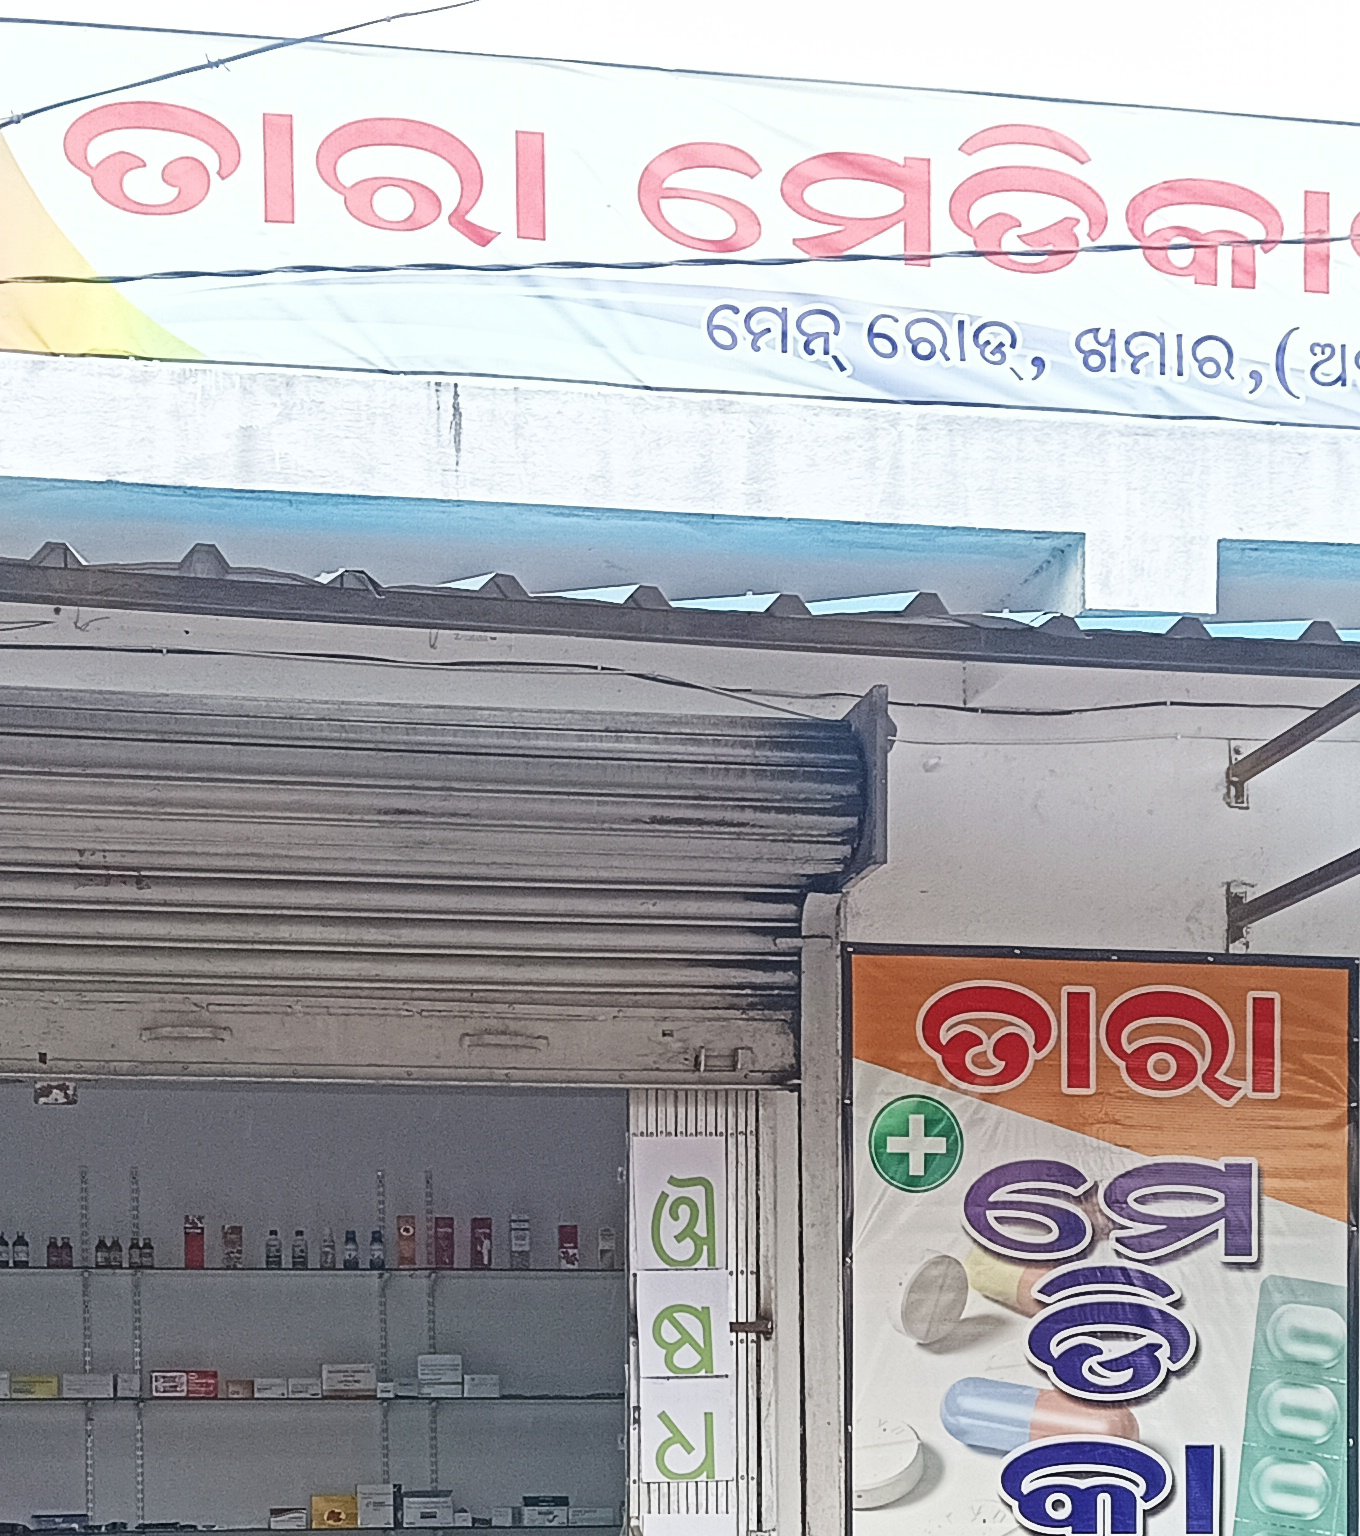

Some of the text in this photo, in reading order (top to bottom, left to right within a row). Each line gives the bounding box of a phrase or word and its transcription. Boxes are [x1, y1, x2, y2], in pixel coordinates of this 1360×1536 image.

[61, 98, 547, 249] ତାରା
[706, 303, 849, 373] ମେନ୍
[866, 313, 1047, 381] ରୋଡ୍,
[916, 980, 1282, 1107] ତାରା
